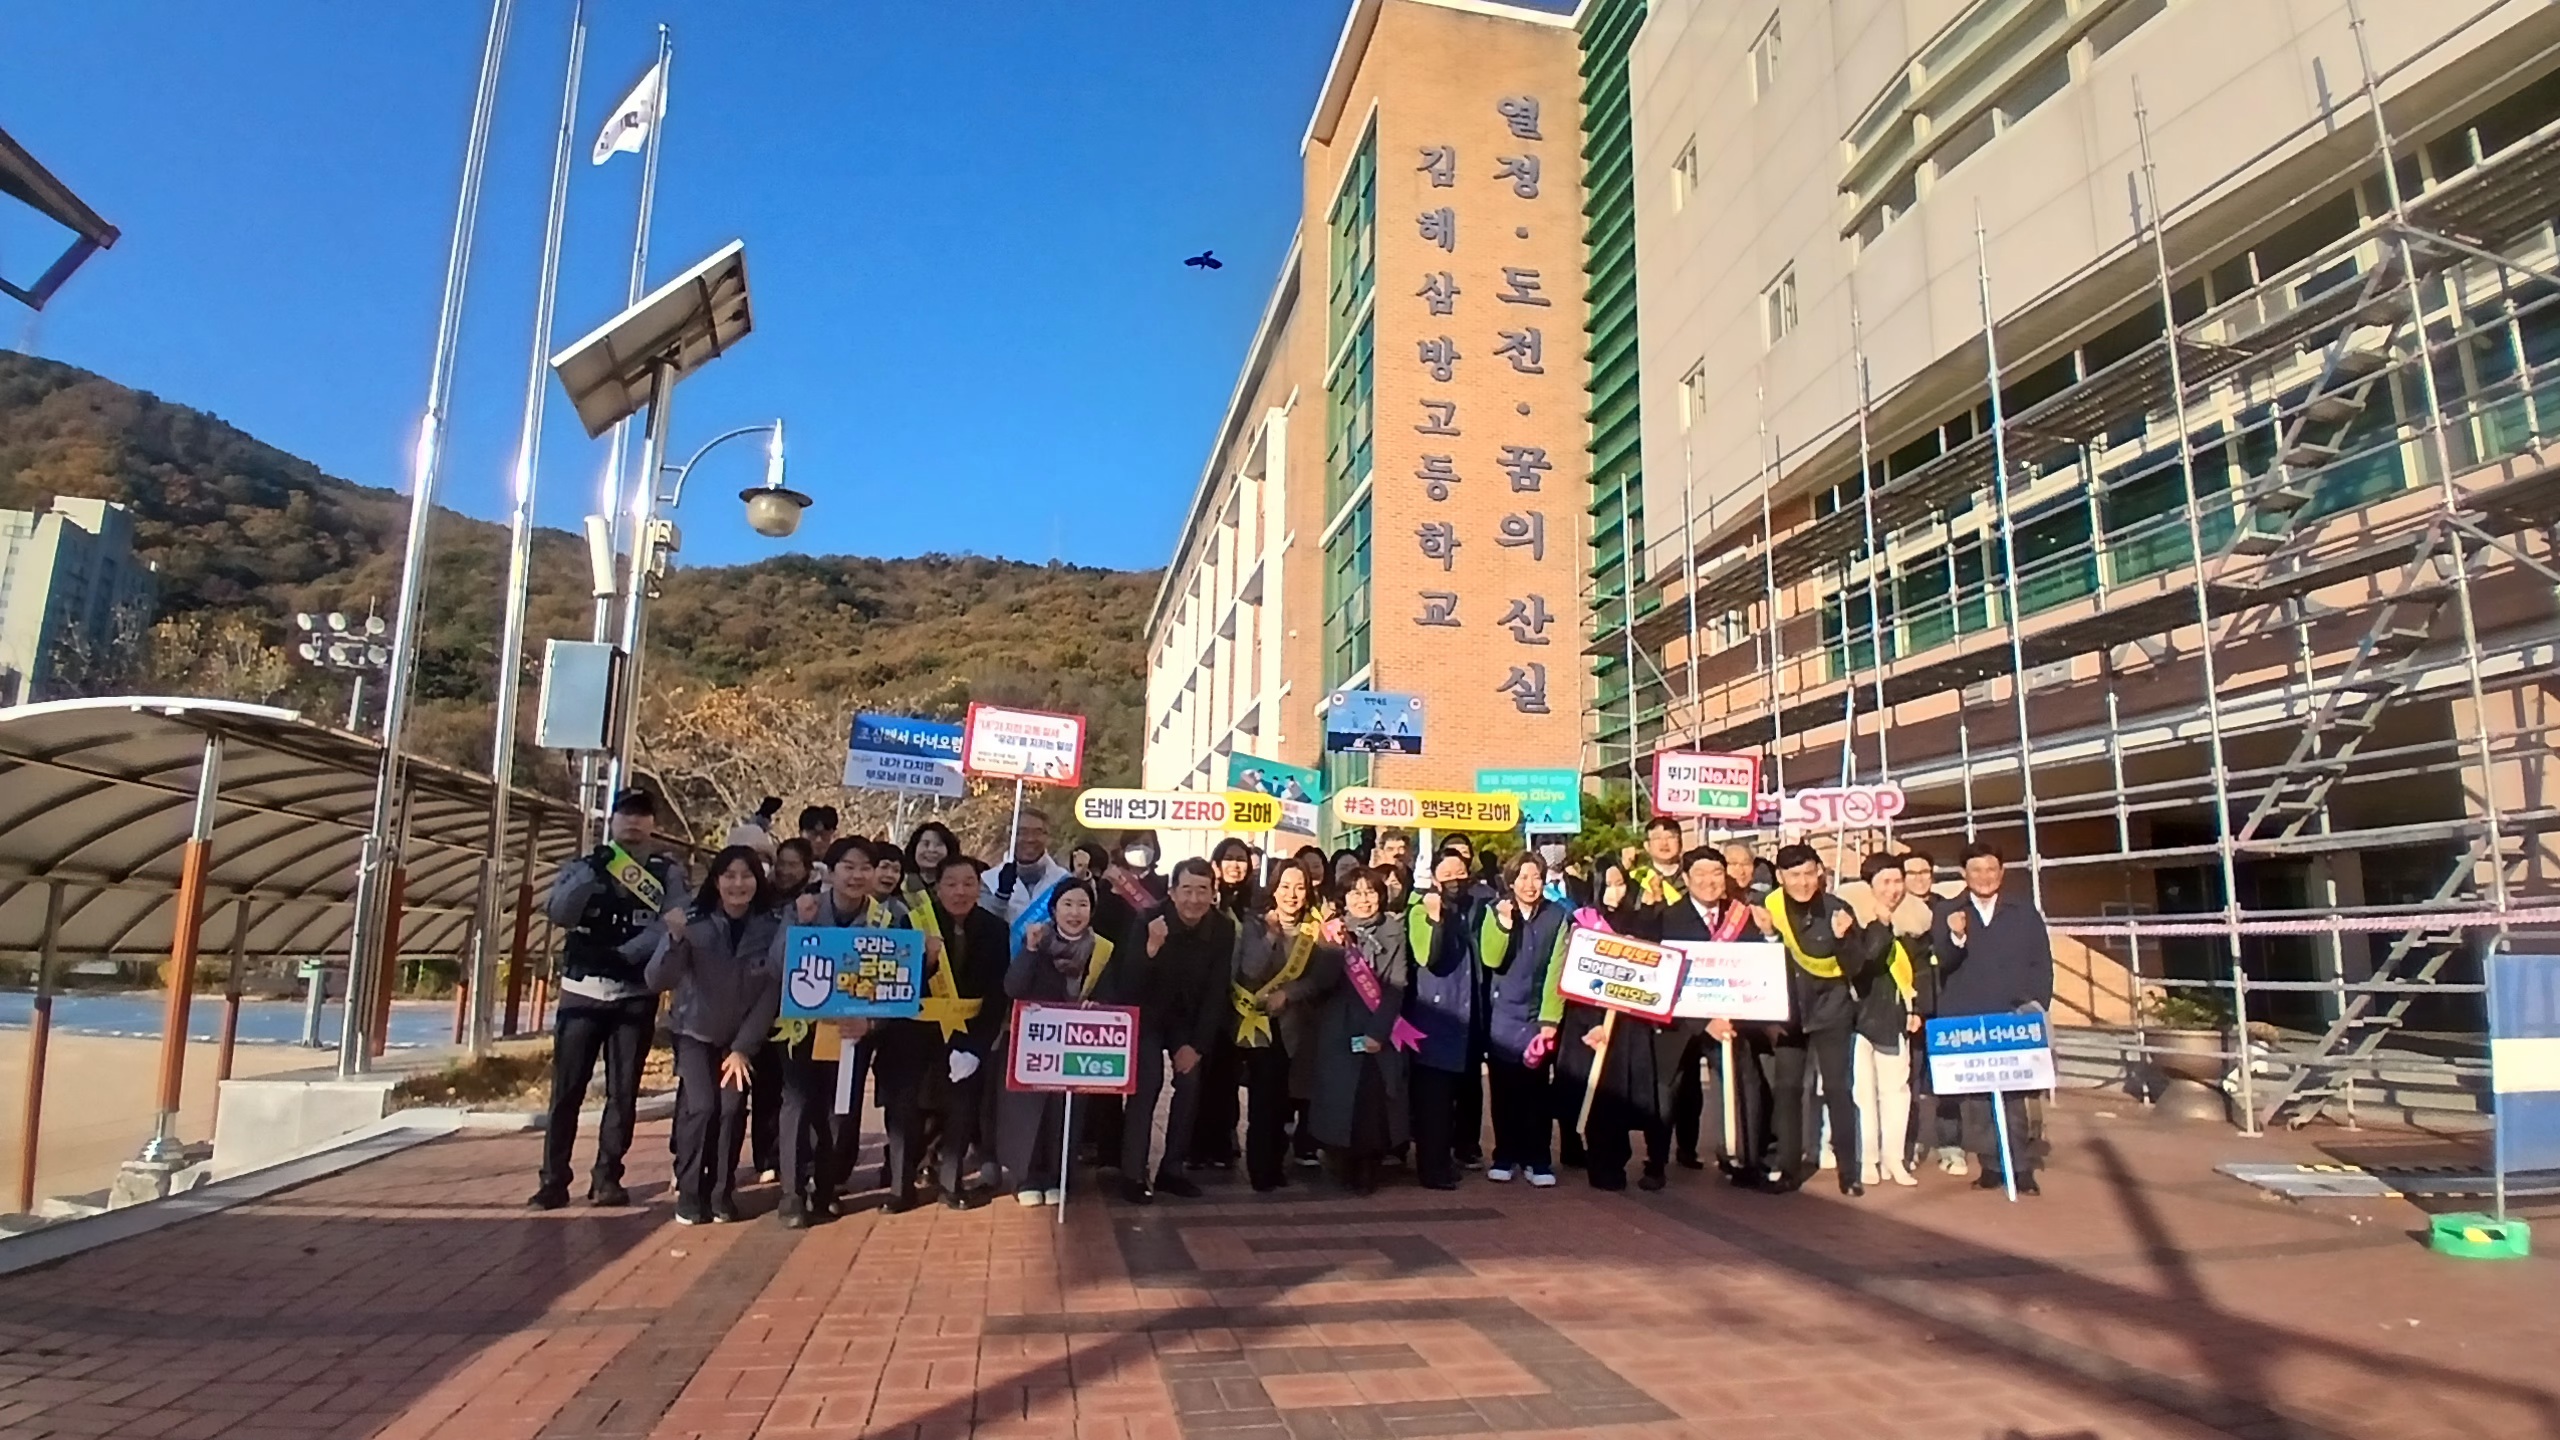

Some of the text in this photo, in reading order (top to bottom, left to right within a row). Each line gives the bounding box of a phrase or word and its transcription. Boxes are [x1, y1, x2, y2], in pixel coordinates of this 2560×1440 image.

[1412, 145, 1461, 628] 김해삼방고등학교
[1496, 593, 1555, 714] 산실
[879, 757, 900, 768] 내가
[910, 773, 921, 784] 더
[923, 776, 945, 787] 아파
[1668, 766, 1696, 781] 뛰기
[1667, 788, 1740, 806] 걷기 Yes
[1084, 798, 1123, 819] 담배
[1128, 798, 1167, 820] 연기
[1171, 801, 1225, 821] ZERO
[1233, 802, 1272, 824] 김해
[1380, 798, 1414, 817] 없이
[1421, 799, 1472, 820] 행복한
[1477, 802, 1511, 822] 김해
[853, 935, 895, 953] 우리는
[1028, 1023, 1062, 1042] 뛰기
[1026, 1053, 1114, 1074] 걷기 Yes
